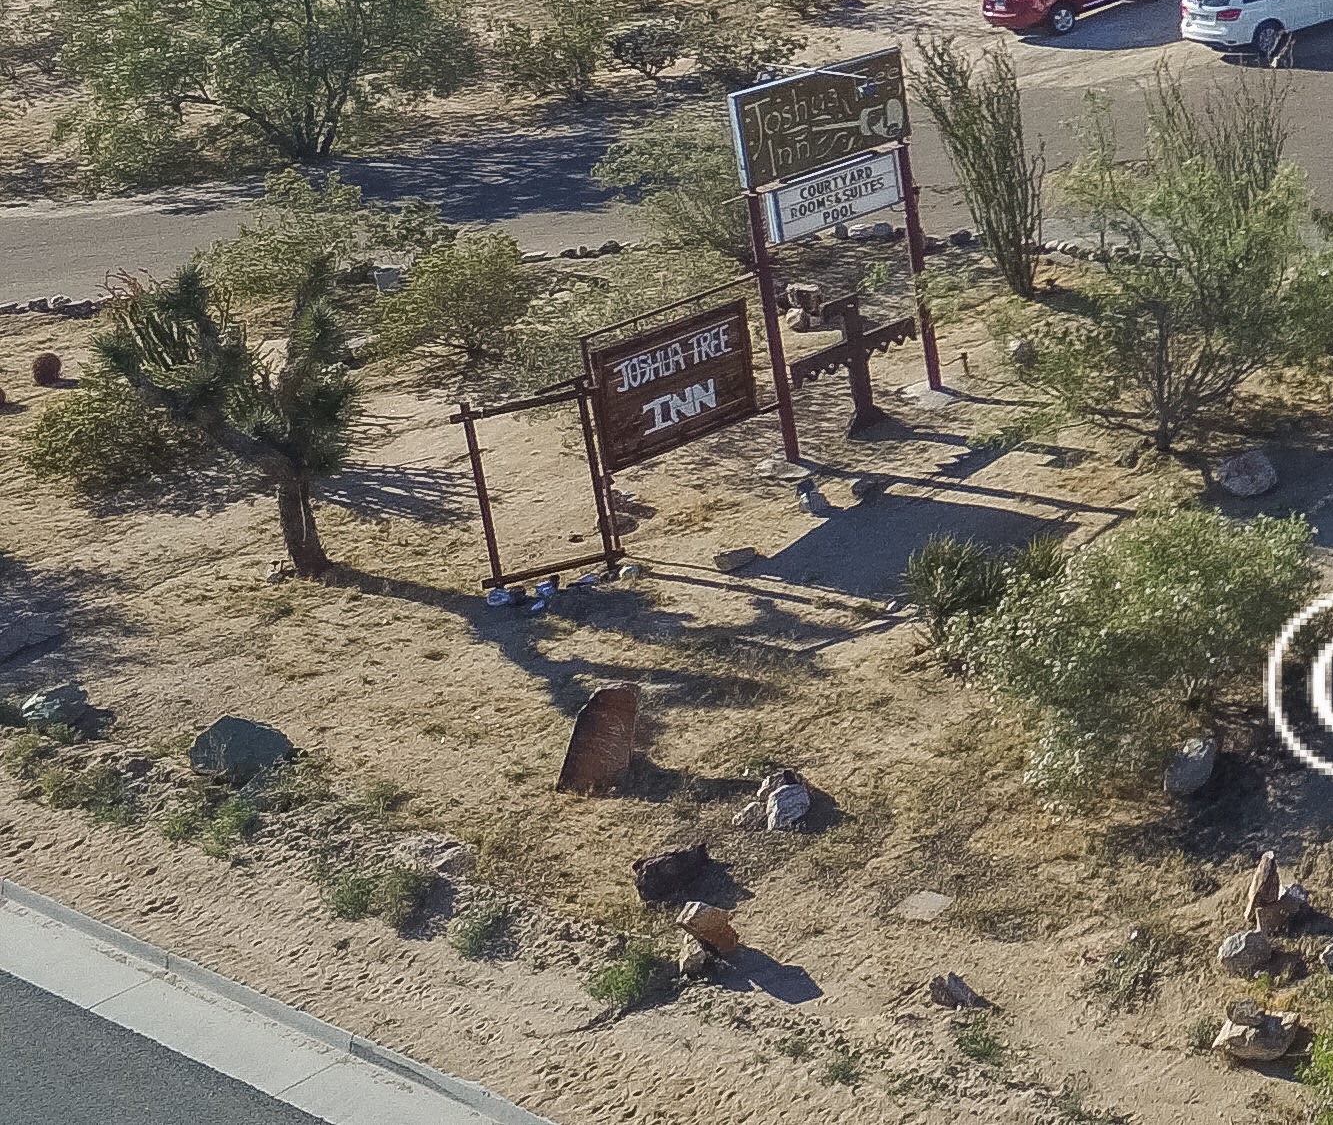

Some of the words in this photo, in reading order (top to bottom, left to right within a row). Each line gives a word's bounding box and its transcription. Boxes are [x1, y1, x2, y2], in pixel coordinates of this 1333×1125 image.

[744, 88, 838, 161] Joshua
[767, 139, 810, 176] Inn
[800, 166, 873, 200] COURTYARD
[823, 203, 857, 225] POOL
[613, 342, 686, 393] JOSHUA
[688, 324, 732, 365] TREE
[642, 378, 717, 436] INN
